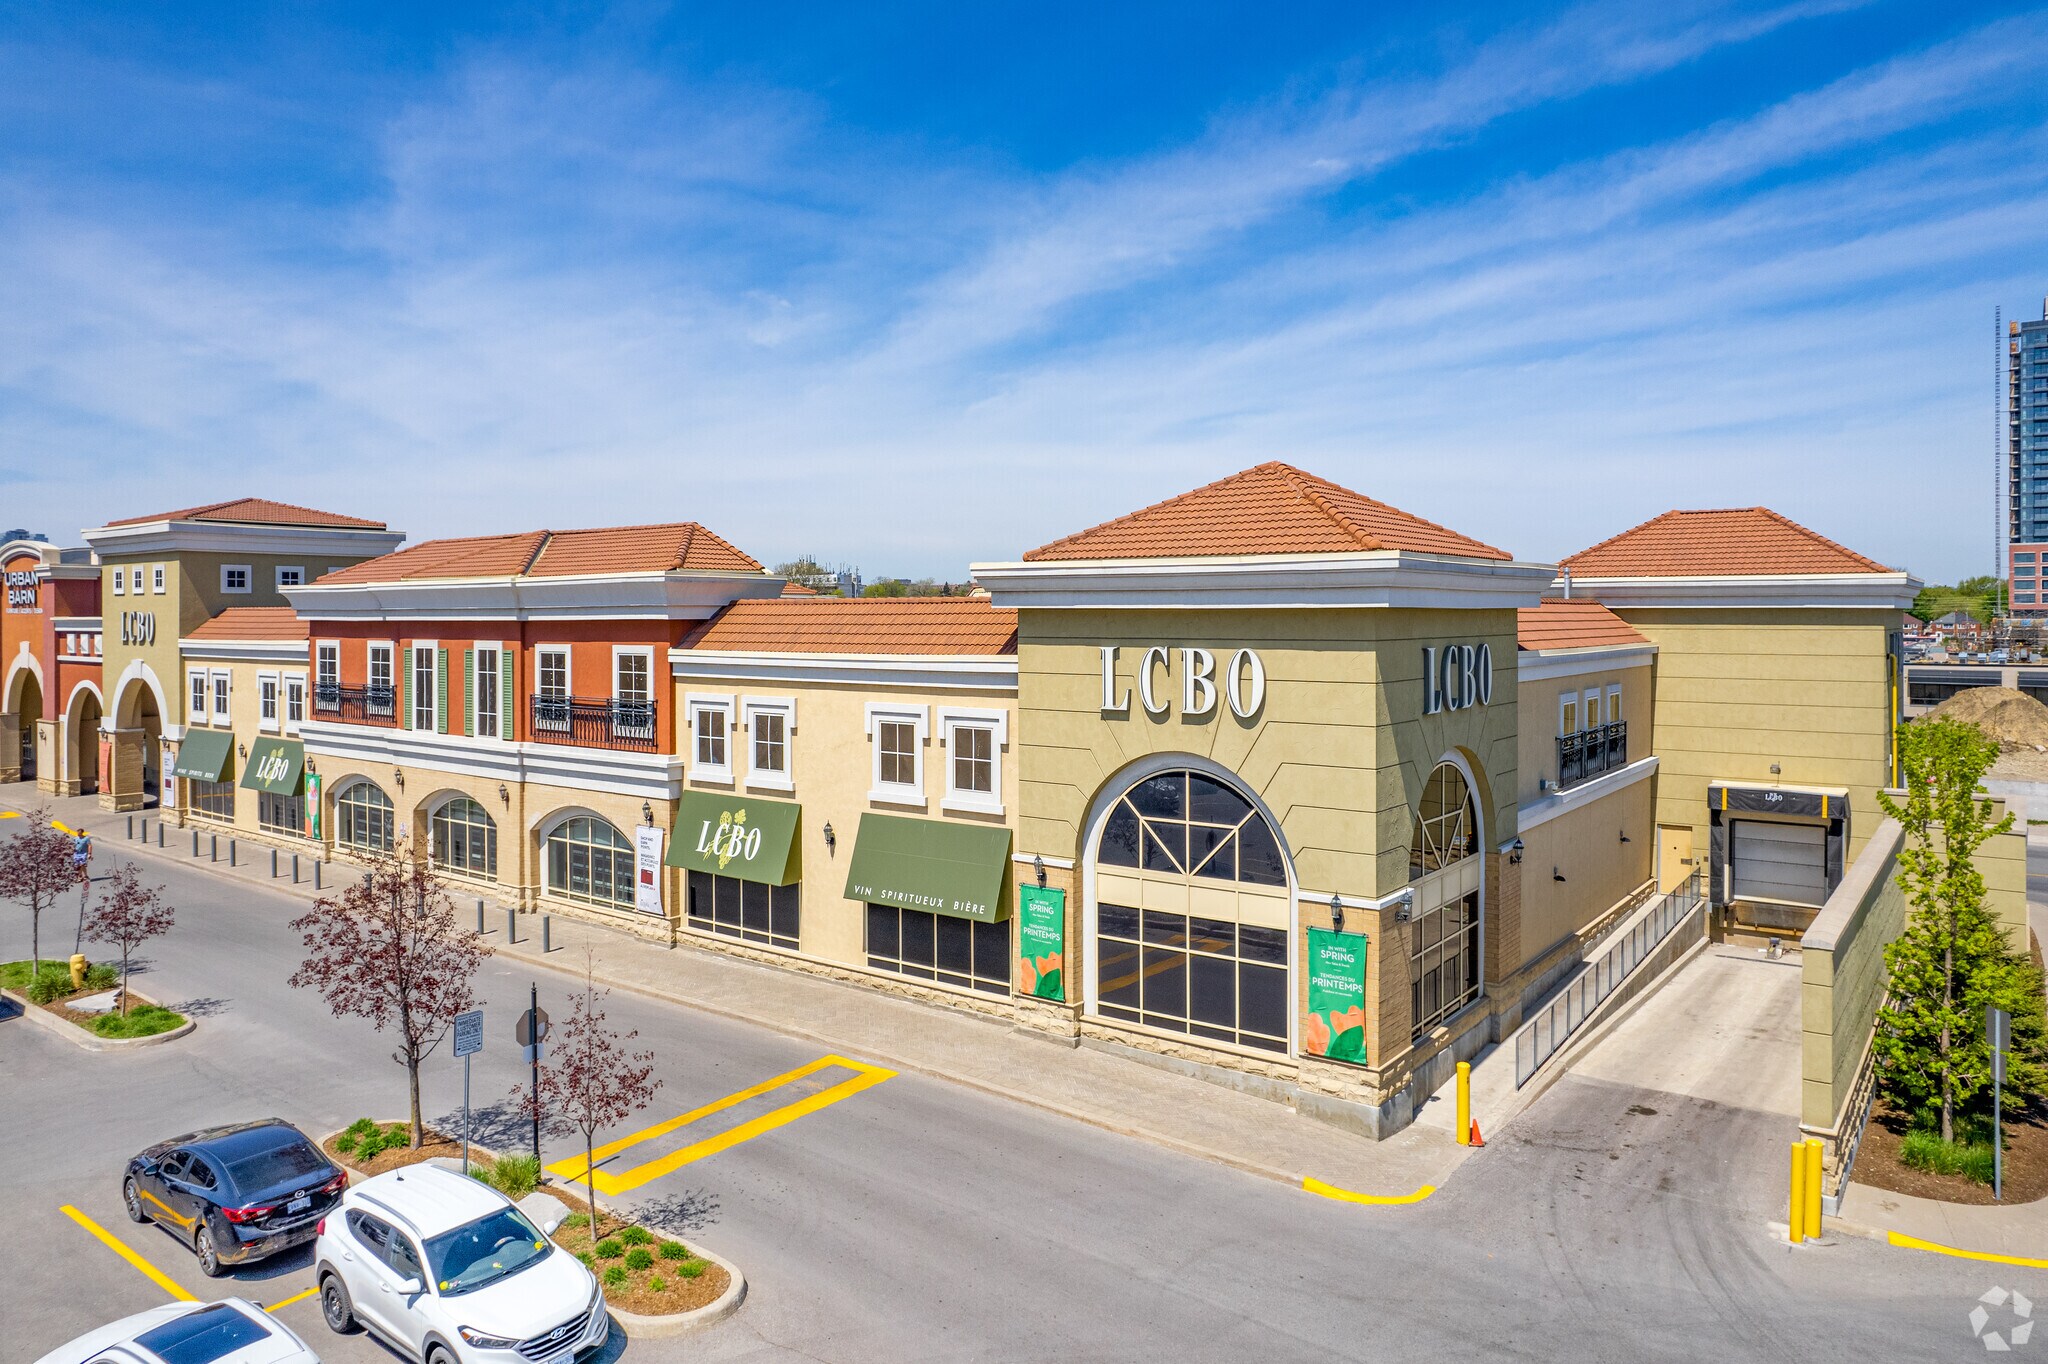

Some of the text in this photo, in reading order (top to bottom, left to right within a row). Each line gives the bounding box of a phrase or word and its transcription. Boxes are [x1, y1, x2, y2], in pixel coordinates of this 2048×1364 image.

[4, 571, 39, 587] URBAN
[8, 589, 36, 605] BARN
[121, 611, 155, 644] LCBO
[1099, 645, 1266, 720] LCBO
[1423, 643, 1493, 715] LCBO
[255, 755, 290, 781] LCBO
[695, 820, 761, 861] LCBO
[854, 885, 985, 915] VIN SPIRITUEUX BIÈRE
[1029, 903, 1054, 915] SPRING
[1023, 926, 1061, 941] PRINTEMPS
[1321, 950, 1354, 962] SPRING
[1312, 976, 1363, 994] PRINTEMPS
[1320, 972, 1348, 981] TENDANCES
